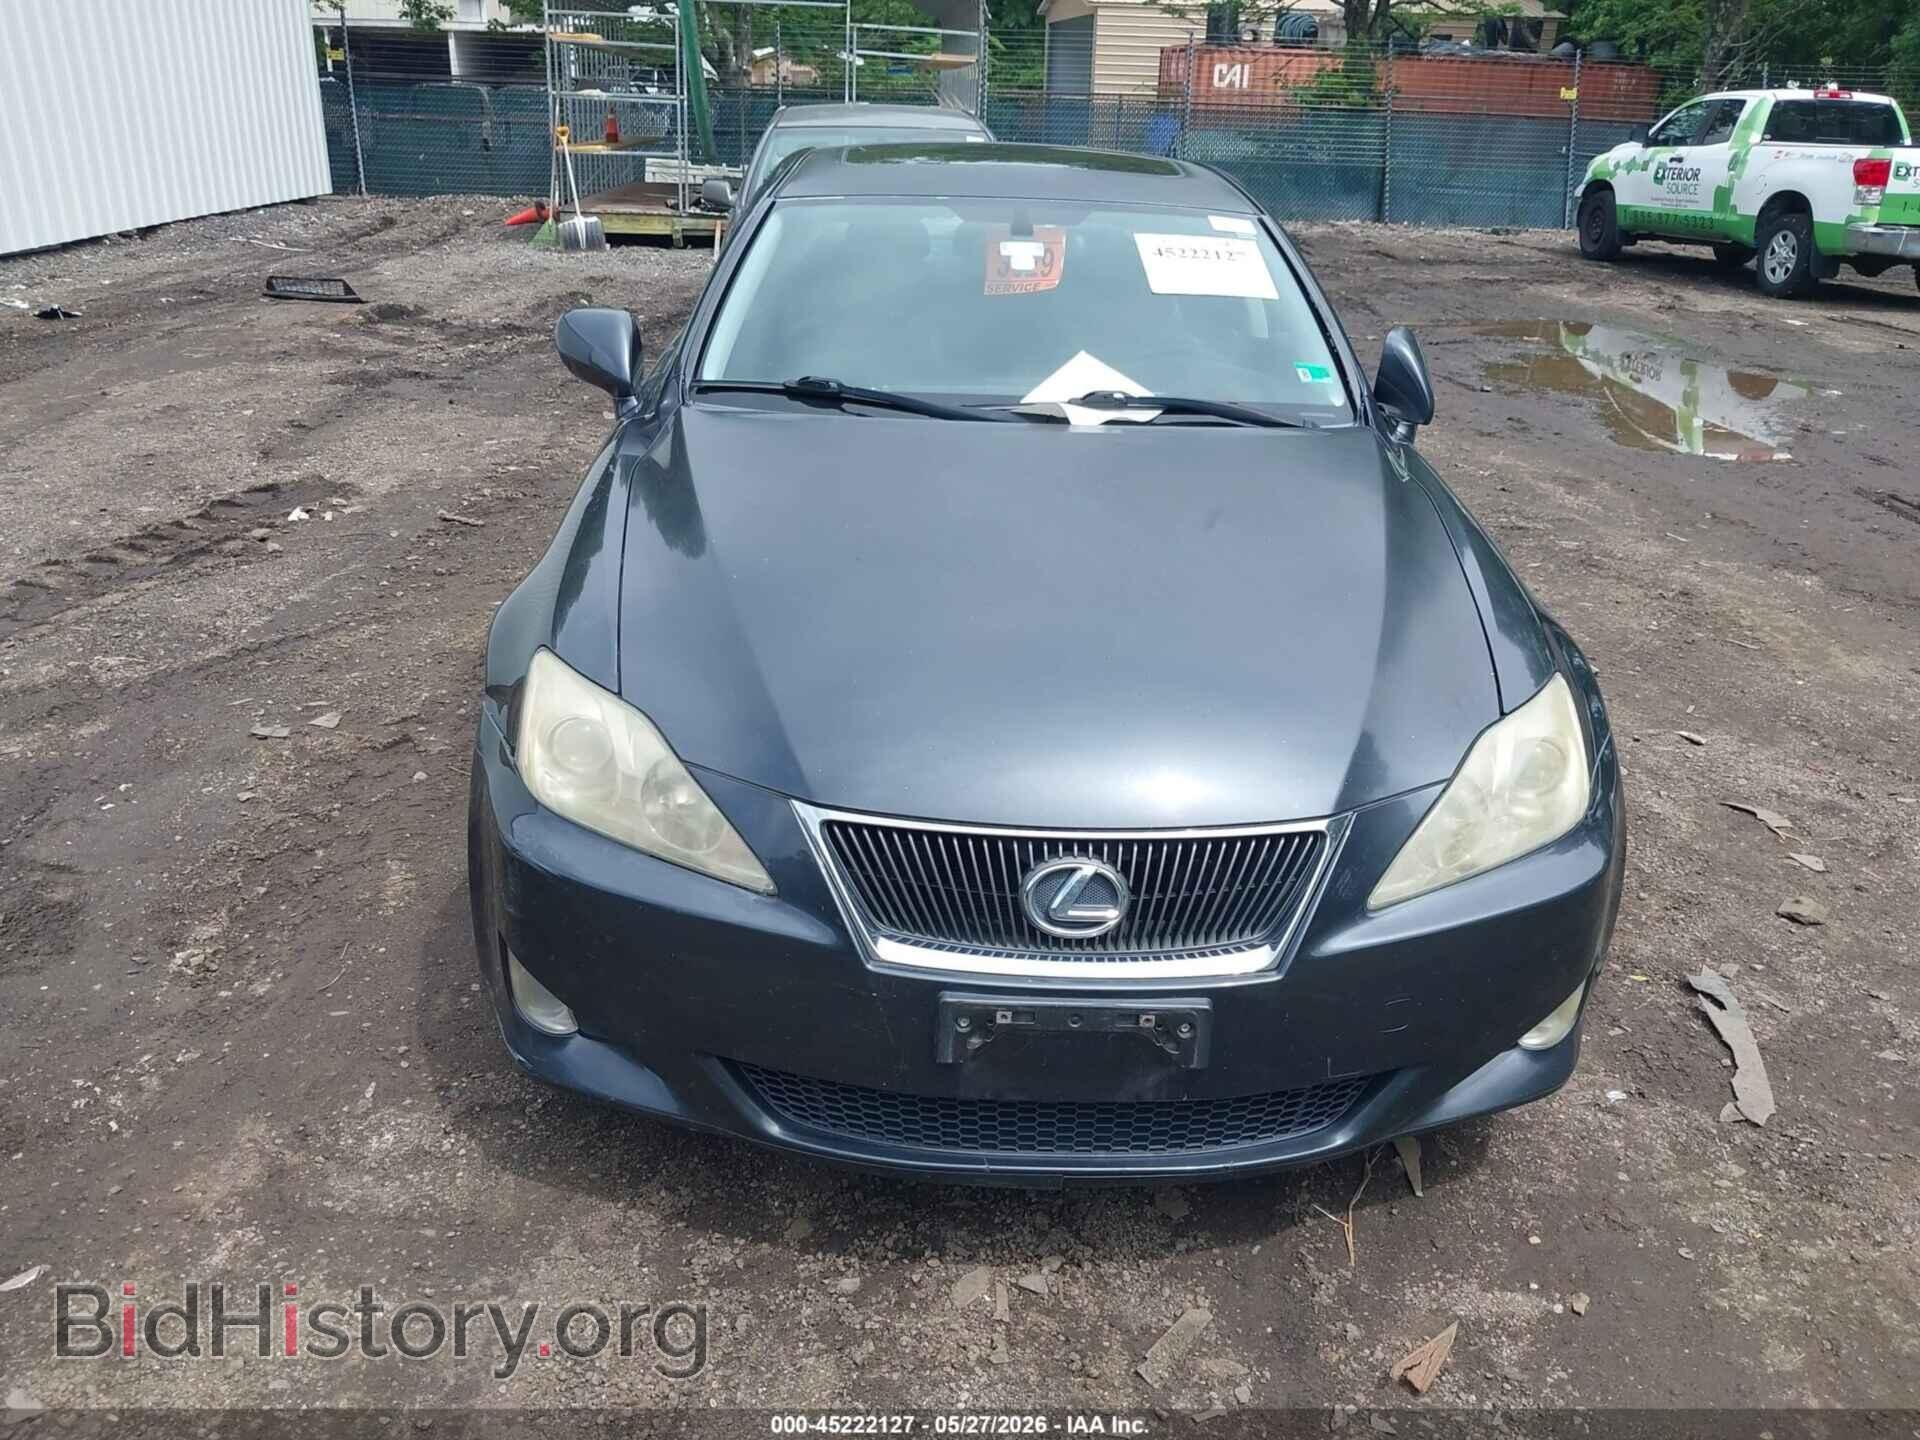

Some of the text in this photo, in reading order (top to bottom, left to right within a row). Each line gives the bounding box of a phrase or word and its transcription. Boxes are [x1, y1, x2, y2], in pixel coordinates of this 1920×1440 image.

[1213, 63, 1249, 88] CAI
[1654, 167, 1701, 181] EXTERIOR
[1666, 183, 1698, 195] SOURCE
[986, 281, 1041, 294] SERVICE
